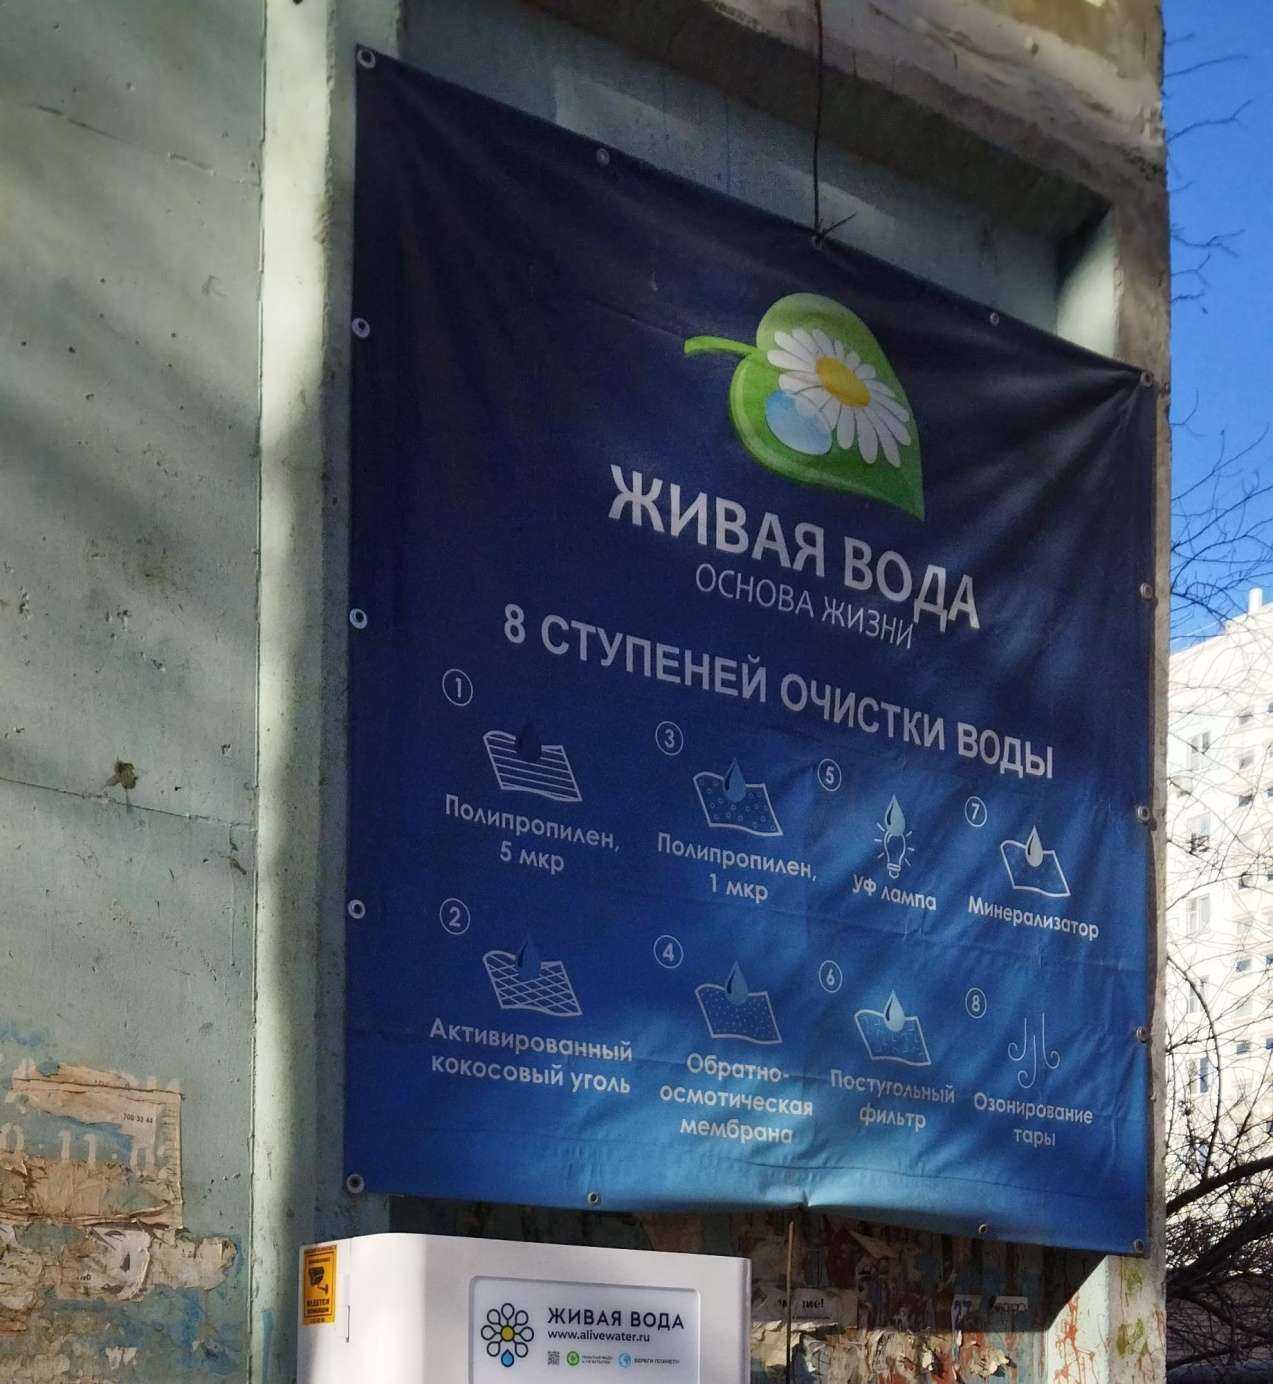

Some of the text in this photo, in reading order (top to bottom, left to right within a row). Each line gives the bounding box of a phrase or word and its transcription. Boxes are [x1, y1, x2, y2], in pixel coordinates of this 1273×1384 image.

[608, 464, 981, 633] ЖИВАЯ ВОДА
[696, 563, 914, 649] ОСНОВА ЖИЗНИ
[504, 604, 1053, 779] 8 СТУПЕНЕЙ ОЧИСТКИ ВОДЫ
[445, 794, 621, 853] Полипропилен,
[500, 842, 565, 875] 5 мкр
[658, 832, 817, 881] Полипропилен,
[709, 874, 769, 904] 1 мкр
[881, 884, 937, 911] лампа
[968, 896, 1099, 941] Минерализатор
[430, 1017, 633, 1063] Активированный
[432, 1055, 630, 1095] кокосовый уголь
[687, 1053, 789, 1084] Обратно-
[660, 1085, 813, 1117] осмотическая
[831, 1069, 955, 1104] Постугольный
[860, 1102, 926, 1130] фильтр
[974, 1092, 1093, 1125] Озонирование
[680, 1117, 793, 1145] мембрана
[1014, 1128, 1056, 1147] тары
[548, 1308, 684, 1331] ЖИВАЯ ВОДА
[548, 1330, 650, 1343] www.alivewater.ru
